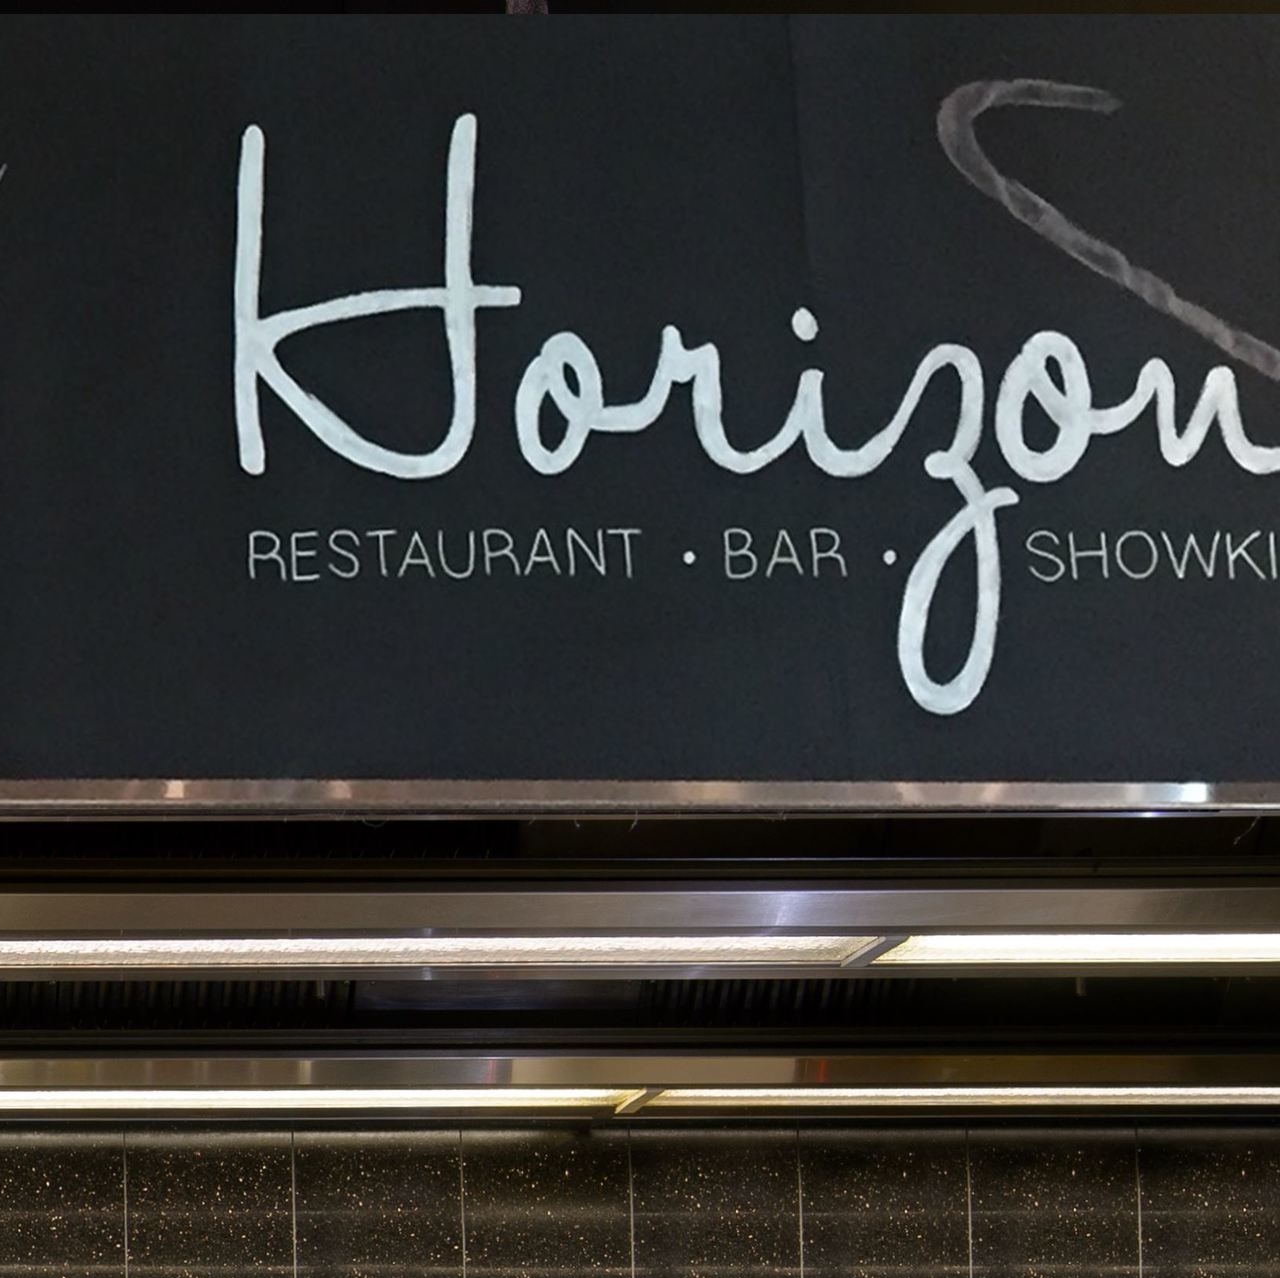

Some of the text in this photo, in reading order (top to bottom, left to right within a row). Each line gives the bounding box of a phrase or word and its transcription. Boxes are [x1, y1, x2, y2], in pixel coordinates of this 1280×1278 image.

[233, 112, 1280, 716] Horizon
[248, 527, 1279, 582] RESTAURANT BAR SHOWKI
